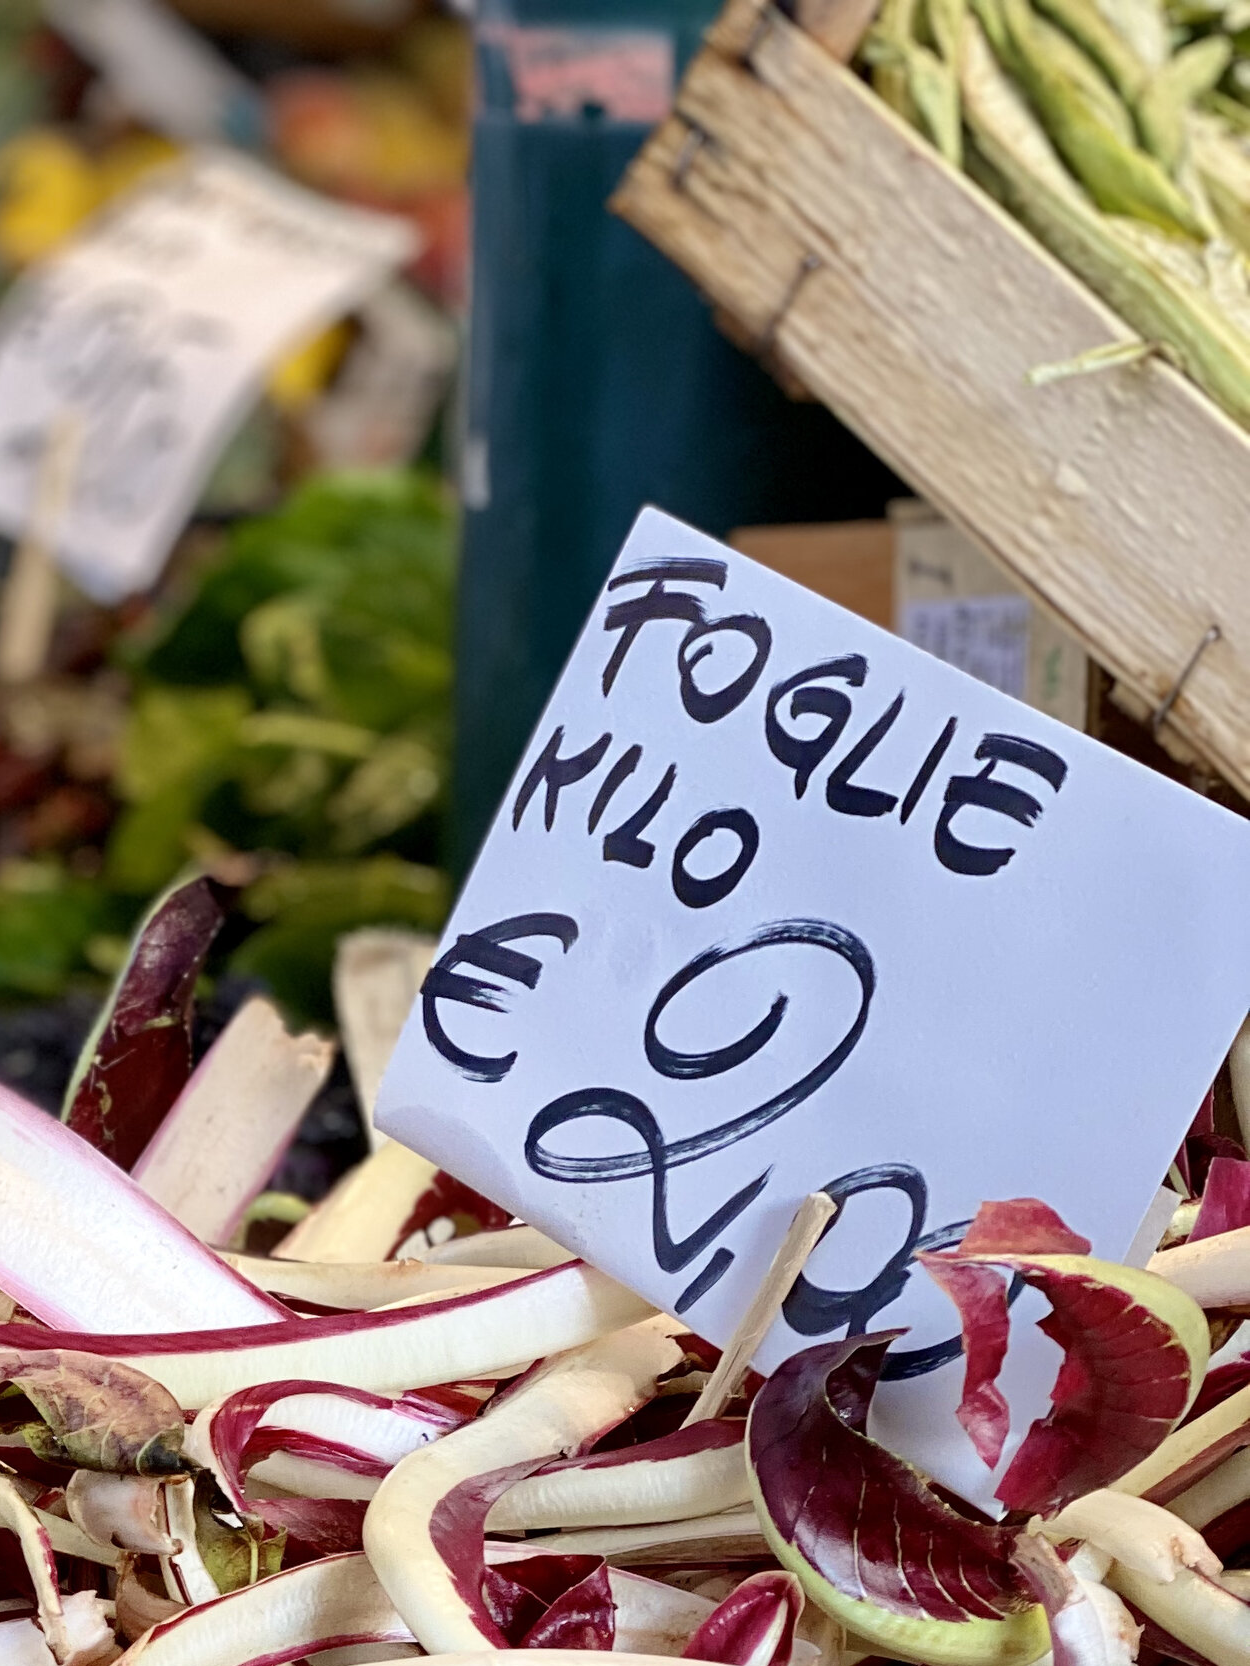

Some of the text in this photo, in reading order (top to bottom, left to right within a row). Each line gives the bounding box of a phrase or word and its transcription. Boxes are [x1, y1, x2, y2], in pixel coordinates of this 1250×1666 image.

[602, 557, 1068, 876] FOGLIE
[513, 723, 761, 908] KILO
[419, 912, 579, 1082] €
